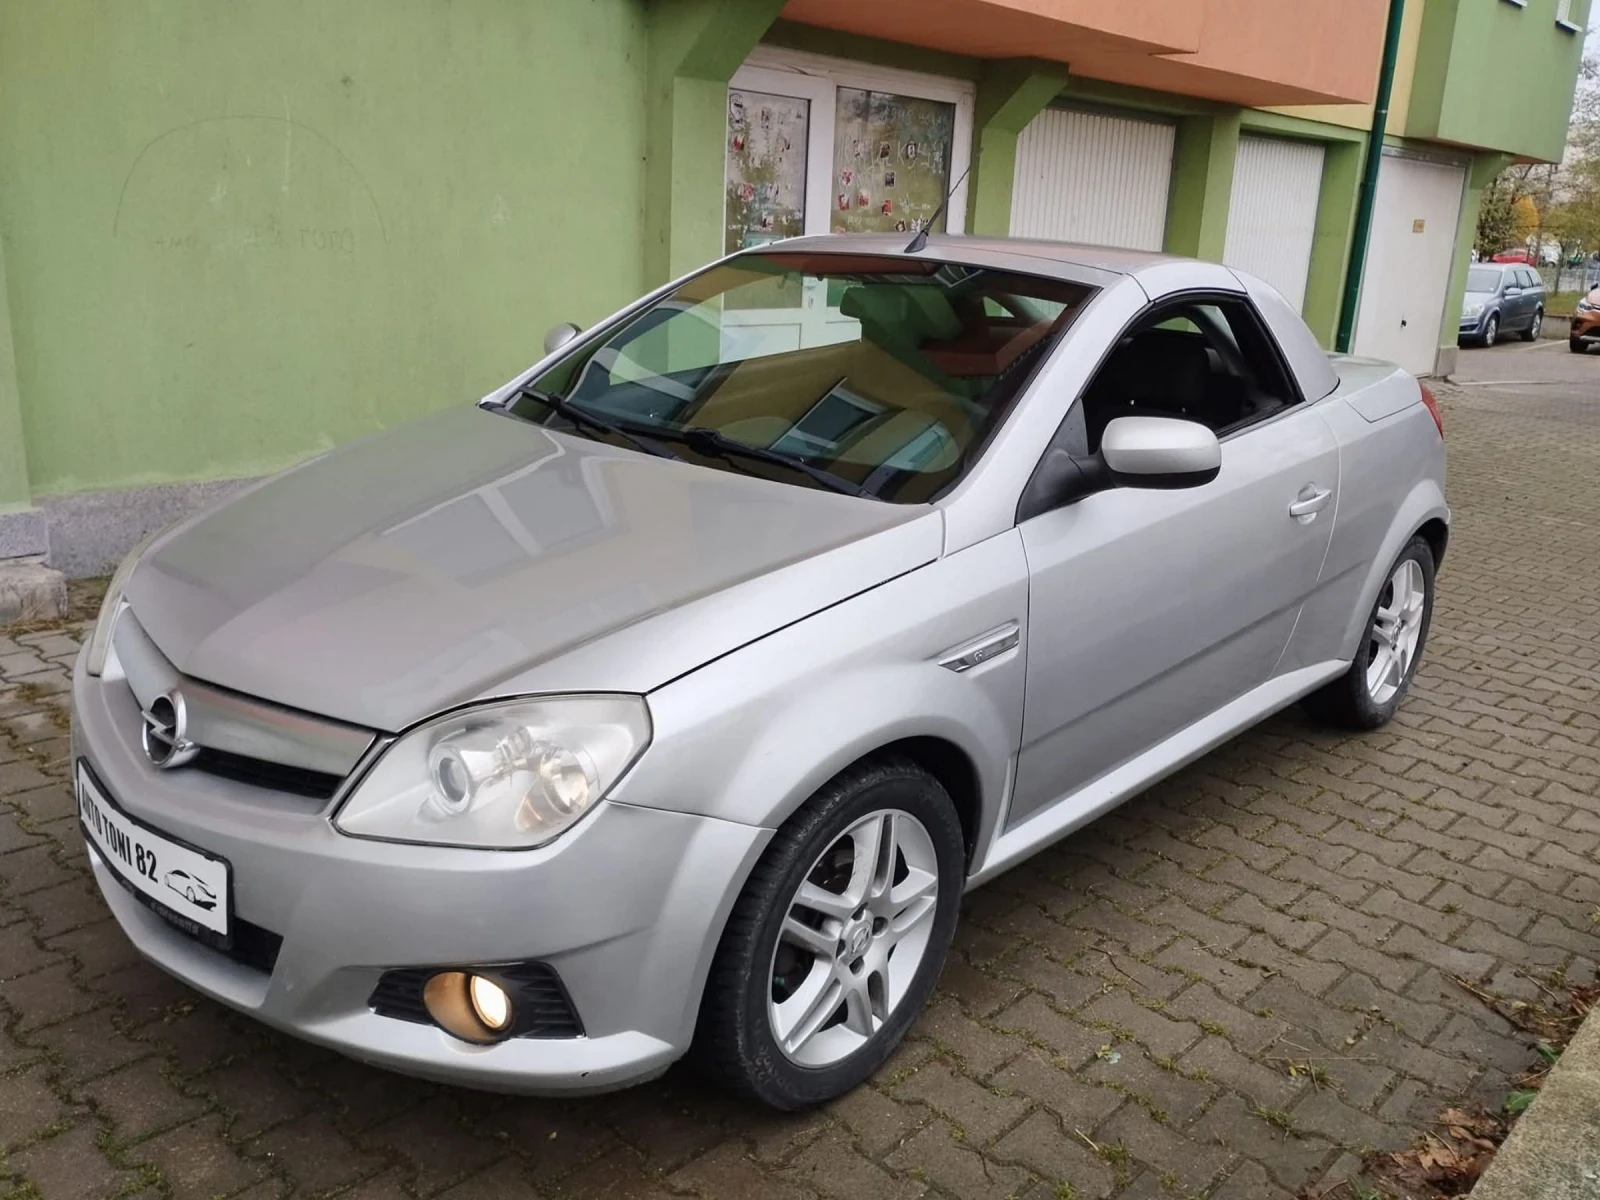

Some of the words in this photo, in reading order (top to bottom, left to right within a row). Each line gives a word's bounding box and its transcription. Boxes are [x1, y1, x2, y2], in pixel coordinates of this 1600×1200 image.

[82, 782, 102, 835] AUTO
[102, 813, 132, 867] TONI
[135, 843, 159, 884] 82
